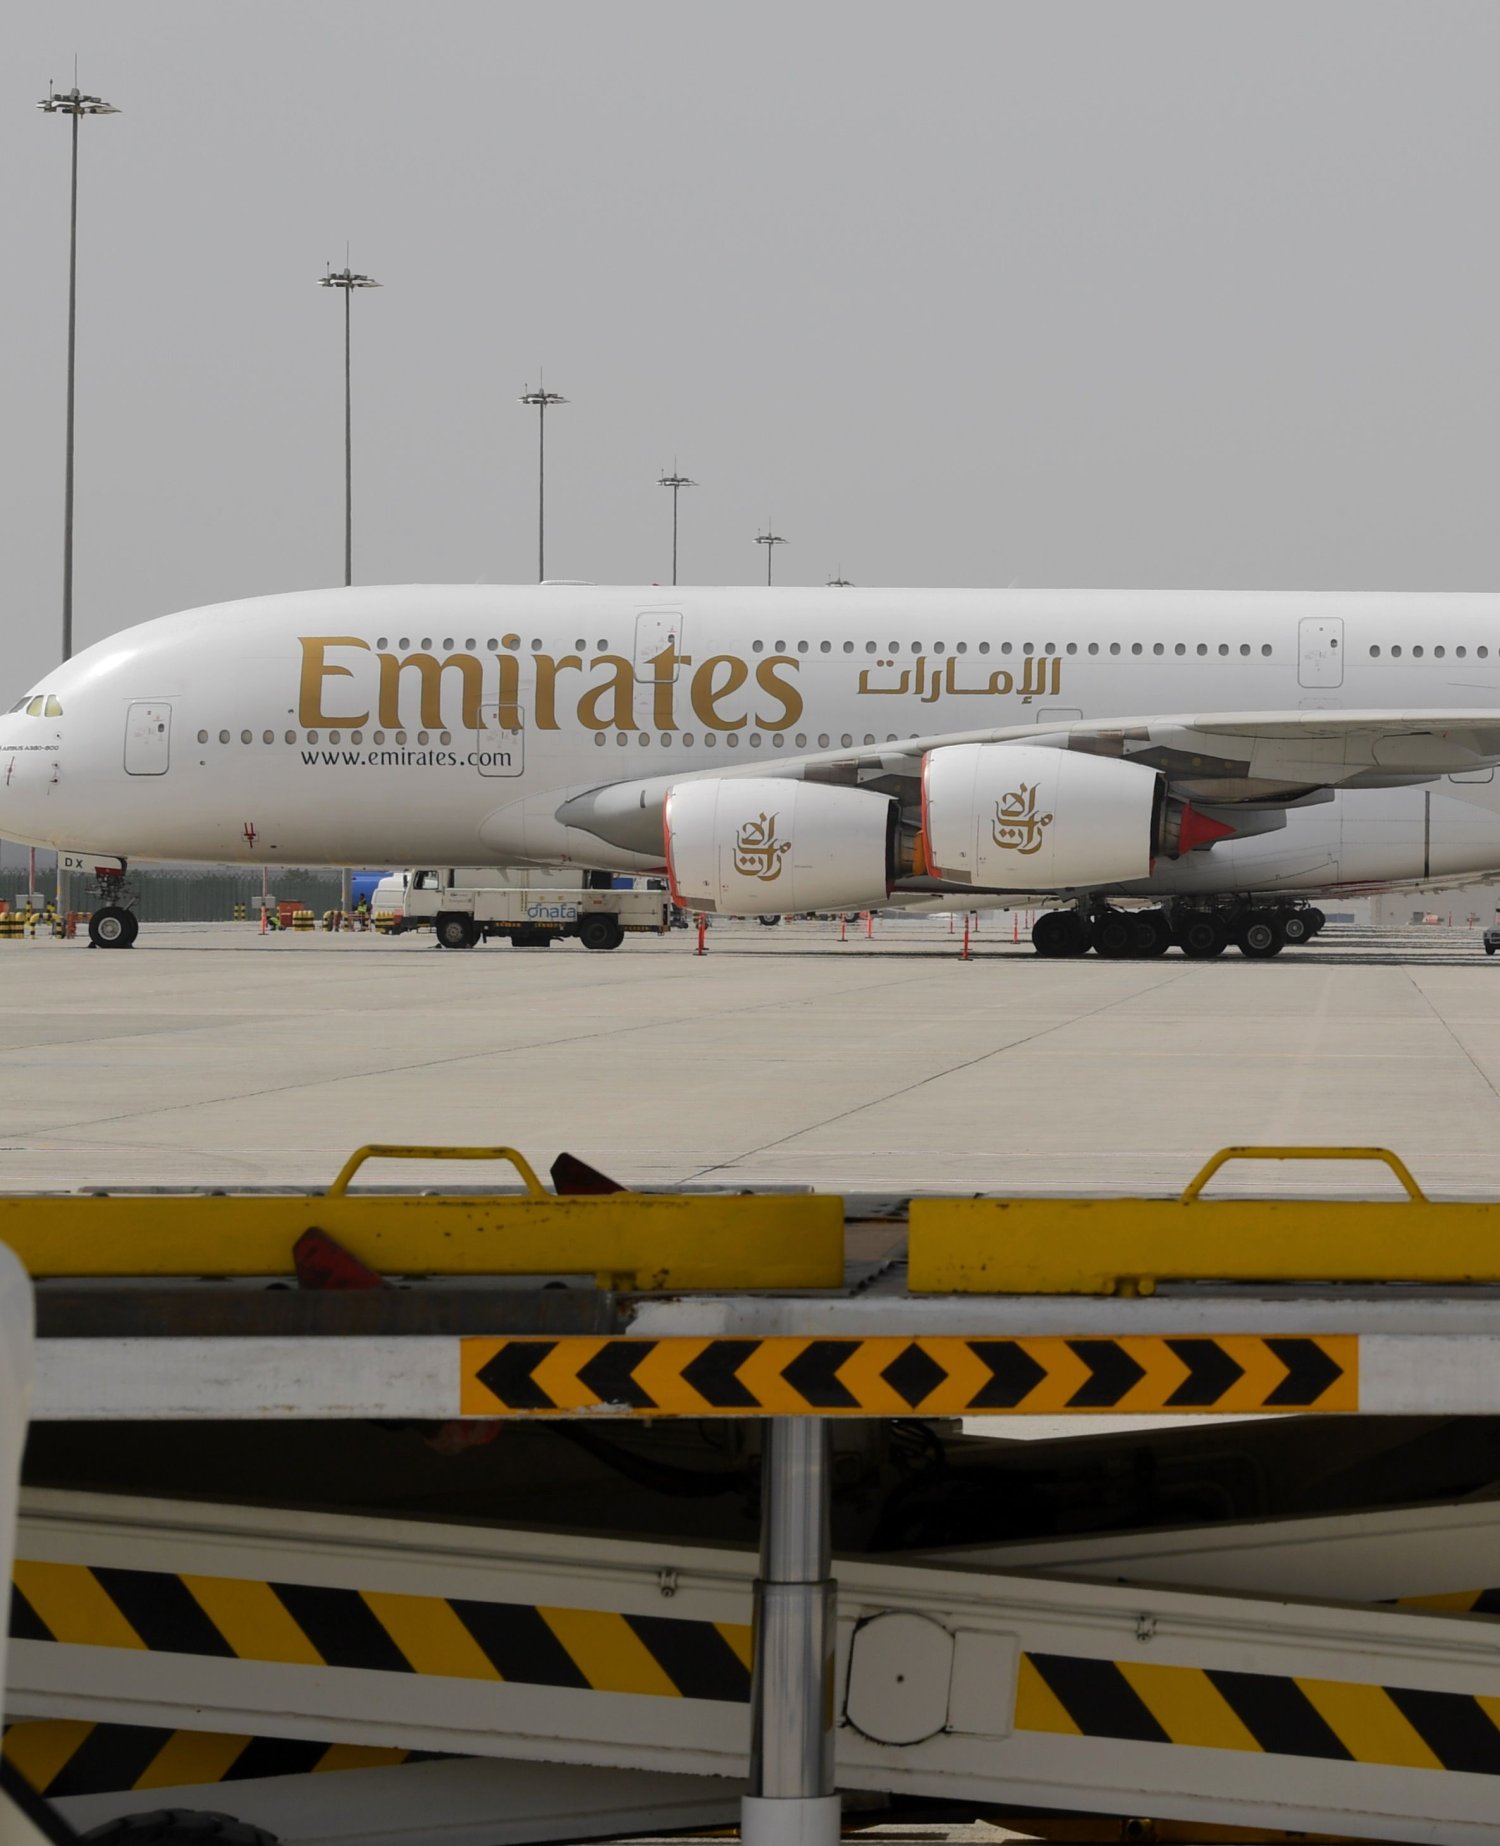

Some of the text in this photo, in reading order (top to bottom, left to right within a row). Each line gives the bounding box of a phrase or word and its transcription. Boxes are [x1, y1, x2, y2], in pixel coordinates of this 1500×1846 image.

[297, 633, 803, 731] Emirates
[856, 656, 1062, 704] الإمارات
[301, 747, 511, 766] www.emirates.com
[527, 903, 577, 919] dnata
